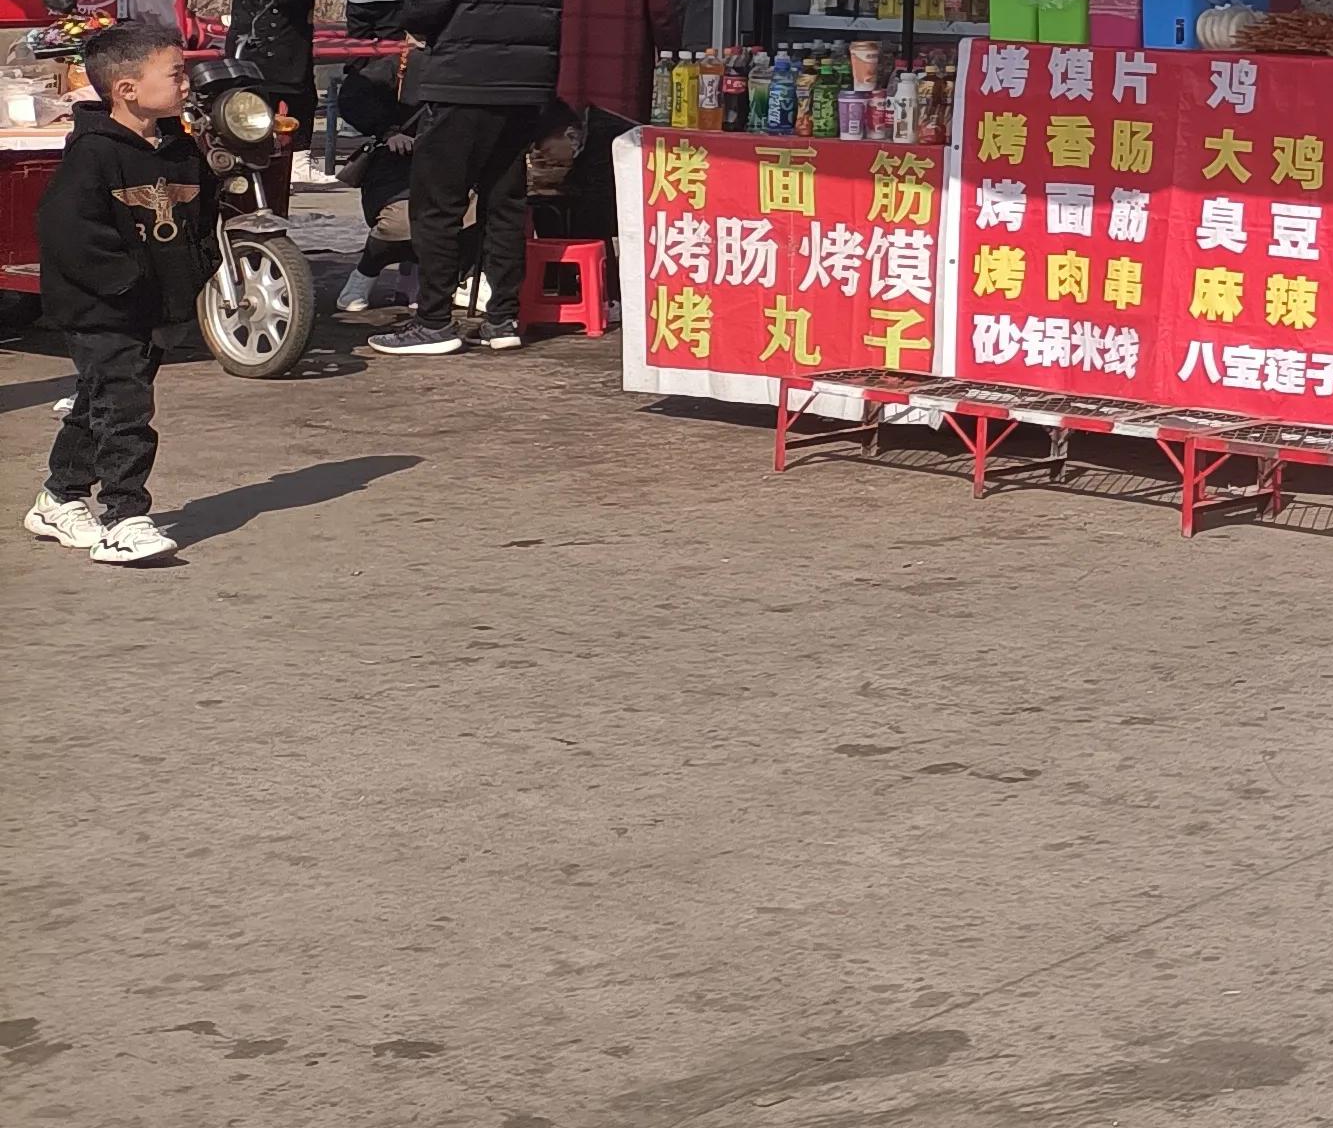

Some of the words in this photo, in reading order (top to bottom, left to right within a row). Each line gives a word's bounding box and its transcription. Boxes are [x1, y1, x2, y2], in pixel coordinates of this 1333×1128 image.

[981, 45, 1157, 105] 烤馍片
[978, 112, 1153, 174] 烤香肠
[647, 137, 935, 224] 烤面筋
[975, 179, 1150, 243] 烤面筋
[649, 211, 778, 287] 烤肠
[798, 221, 934, 305] 烤馍
[973, 245, 1143, 309] 烤肉串
[650, 285, 932, 370] 烤丸子
[972, 314, 1141, 379] 砂锅米线
